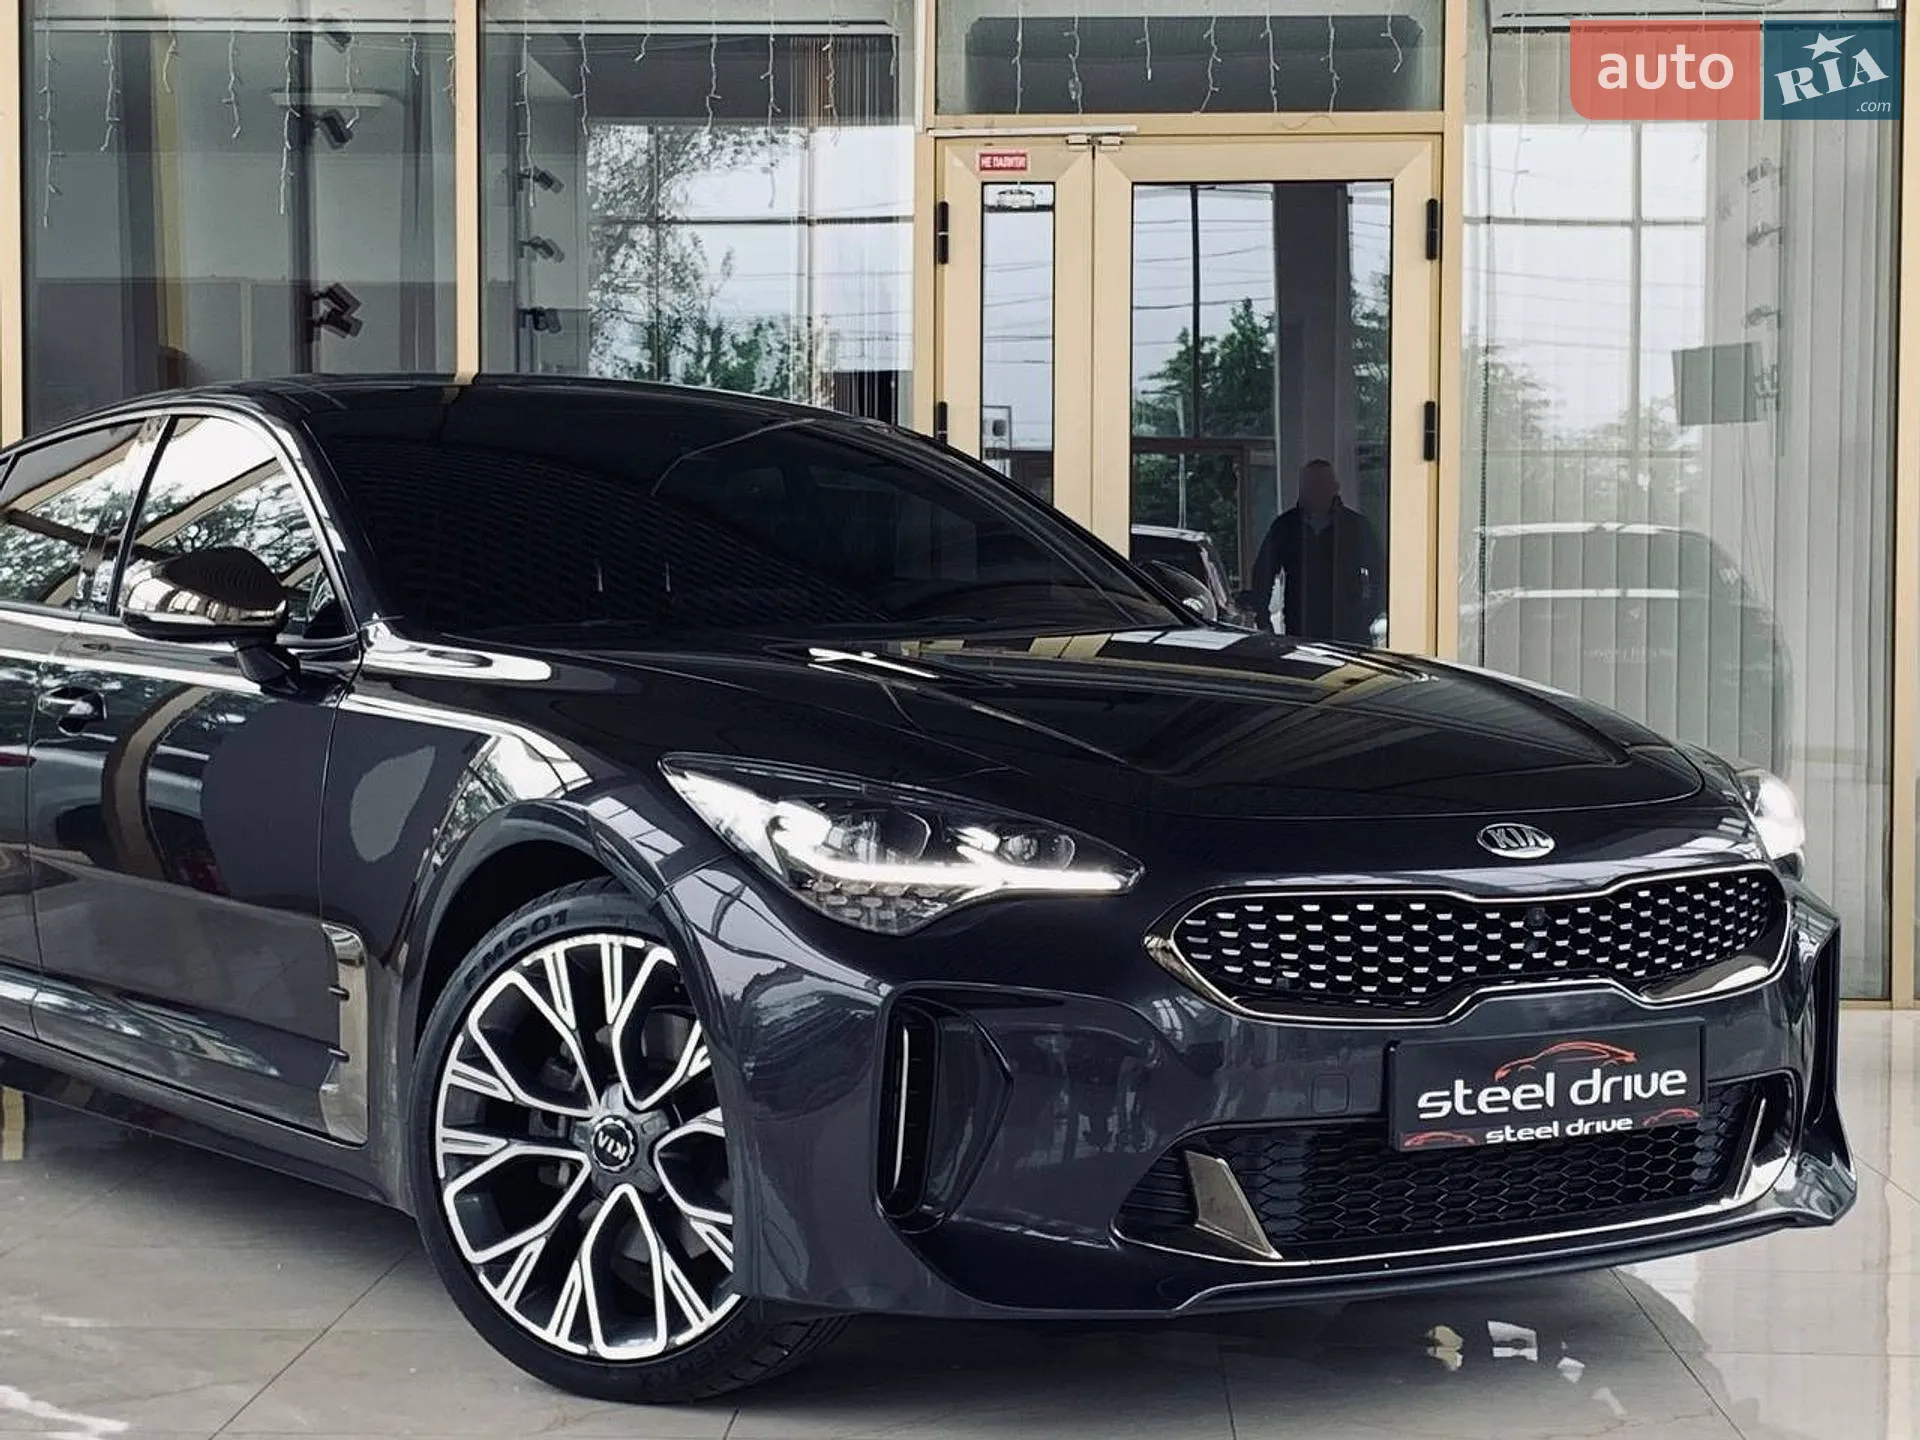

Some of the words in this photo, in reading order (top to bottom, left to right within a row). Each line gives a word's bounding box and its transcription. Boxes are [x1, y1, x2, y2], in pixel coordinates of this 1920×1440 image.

[1487, 826, 1549, 848] KIA
[1417, 1072, 1555, 1119] steel
[1569, 1068, 1688, 1106] drive
[1485, 1121, 1558, 1144] steel
[1565, 1118, 1633, 1137] drive
[598, 1131, 627, 1160] KIA
